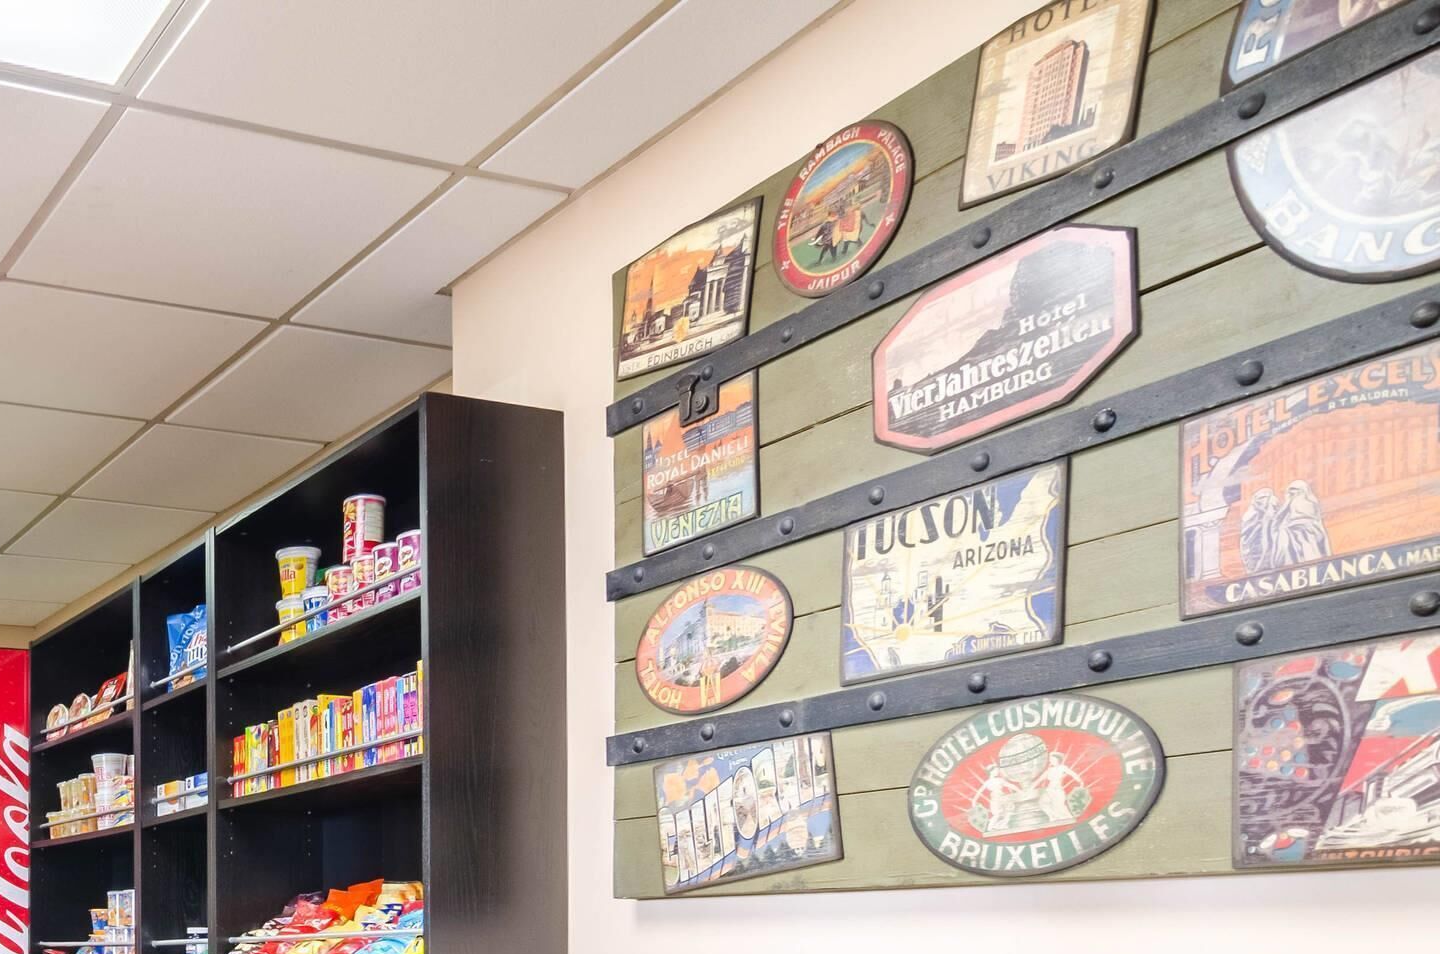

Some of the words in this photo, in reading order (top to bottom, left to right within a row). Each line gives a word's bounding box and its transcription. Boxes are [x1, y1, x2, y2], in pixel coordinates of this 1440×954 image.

[777, 198, 794, 229] THE
[799, 127, 861, 180] RAMBAGH
[877, 127, 906, 174] PALACE
[987, 137, 1099, 192] VIKING
[807, 259, 860, 291] JAIPUR
[647, 337, 713, 368] EDINBURGH
[938, 362, 1054, 422] HAMBURG
[646, 460, 688, 491] ROYAL
[690, 436, 749, 472] DANIELI
[654, 447, 691, 469] HOTEL
[1185, 396, 1292, 506] HOTEL
[650, 492, 744, 548] VENEZIA
[855, 483, 996, 561] TUCSON
[953, 535, 1036, 569] ARIZONA
[1225, 553, 1395, 603] CASABLANCA
[646, 570, 727, 646] ALFONSO
[730, 569, 767, 595] XIII
[641, 657, 682, 710] HOTEL
[922, 722, 989, 787] HOTEL
